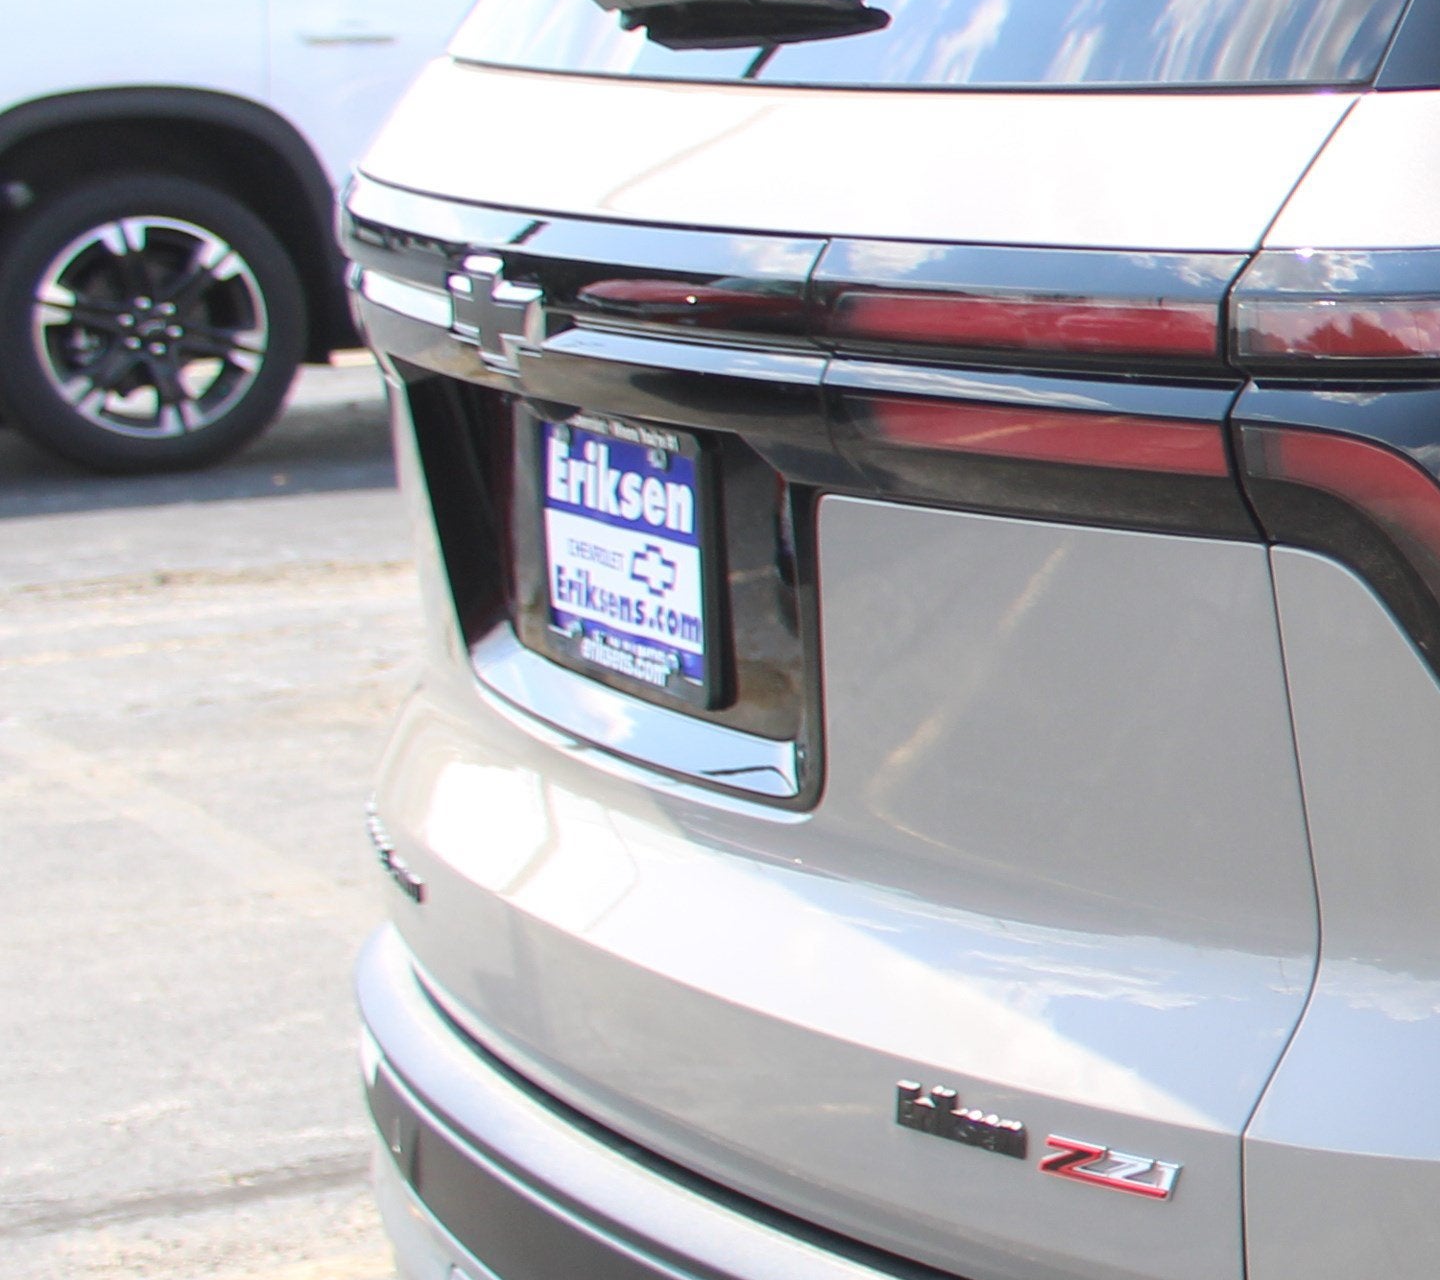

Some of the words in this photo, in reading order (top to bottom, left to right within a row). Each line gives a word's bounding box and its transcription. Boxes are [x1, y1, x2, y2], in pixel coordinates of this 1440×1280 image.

[548, 437, 695, 535] Eriksen
[555, 564, 702, 644] Eriksens.com
[1038, 1134, 1184, 1202] Z71
